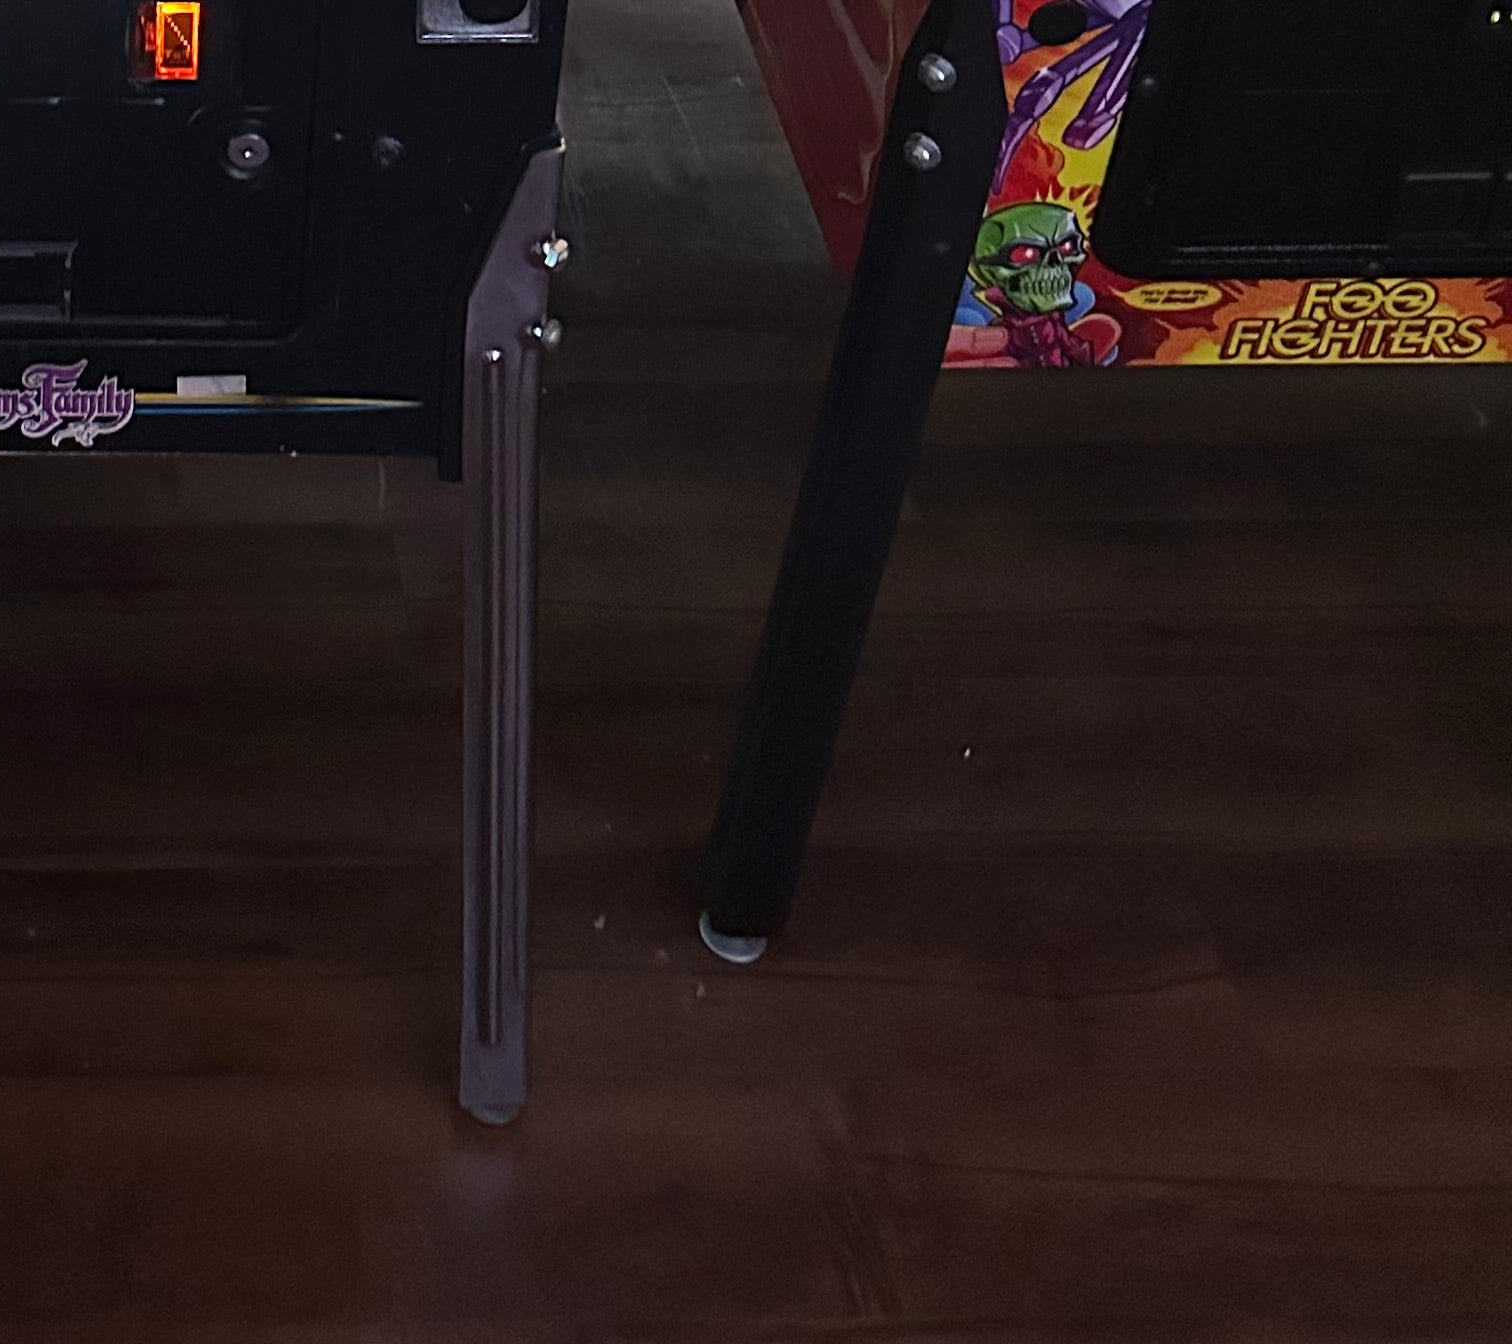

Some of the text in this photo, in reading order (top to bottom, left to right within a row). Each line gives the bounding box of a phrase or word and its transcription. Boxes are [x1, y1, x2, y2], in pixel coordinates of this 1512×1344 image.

[1298, 279, 1438, 321] FOO
[1220, 316, 1487, 359] FIGHTERS
[21, 359, 137, 446] Family
